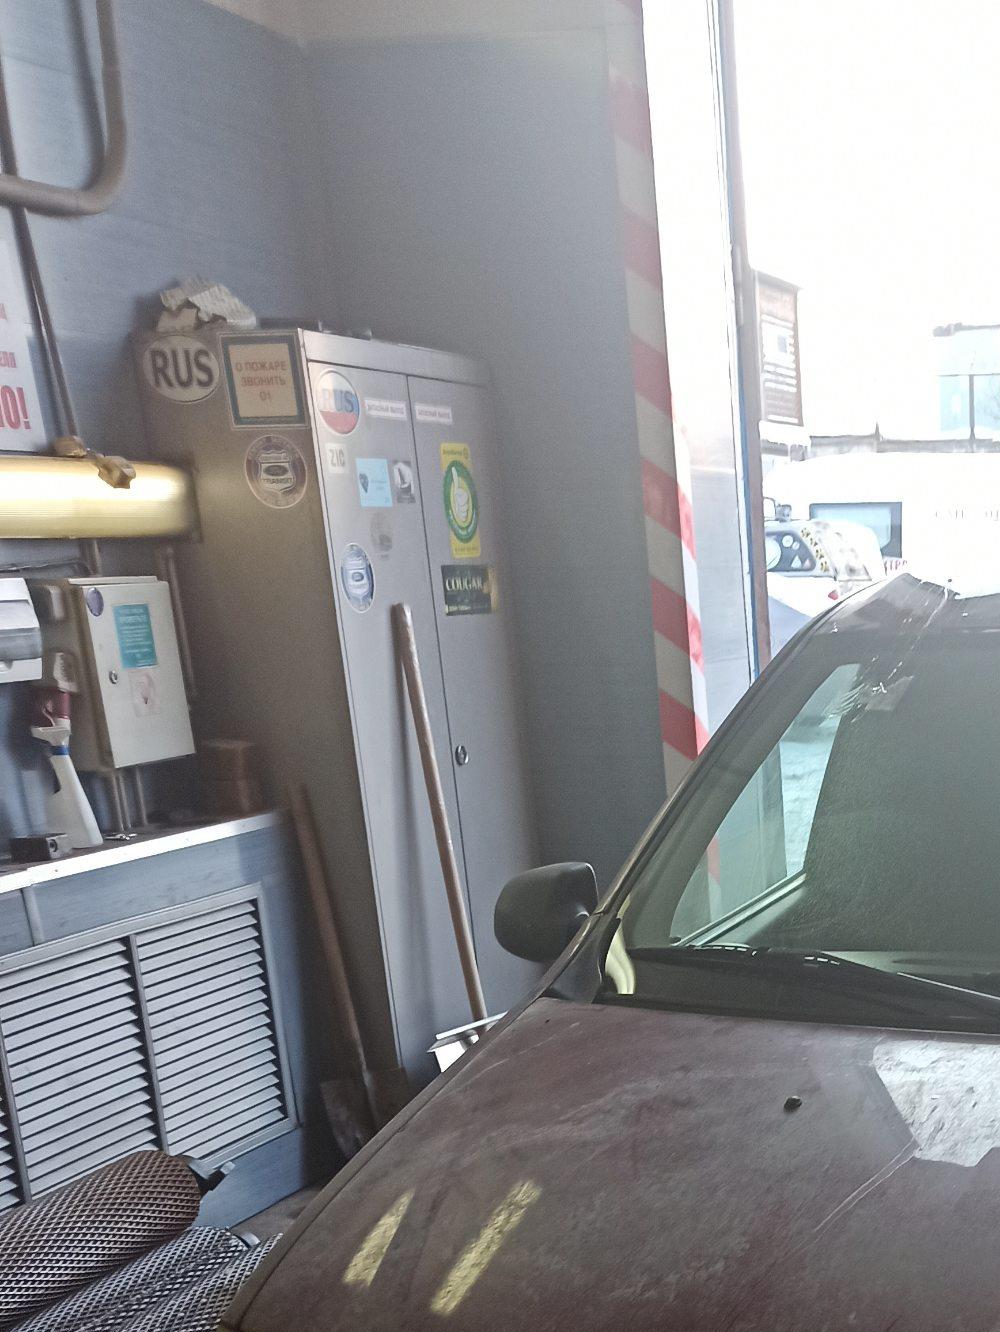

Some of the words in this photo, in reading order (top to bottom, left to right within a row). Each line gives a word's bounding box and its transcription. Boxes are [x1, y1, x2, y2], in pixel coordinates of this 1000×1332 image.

[150, 350, 213, 387] RUS
[235, 362, 242, 371] О
[244, 361, 288, 371] ПОЖАРЕ
[241, 376, 286, 387] ЗВОНИТЬ
[259, 391, 271, 401] 01
[321, 388, 354, 412] RUS
[330, 448, 346, 467] ZIC
[445, 576, 483, 591] COUGAR
